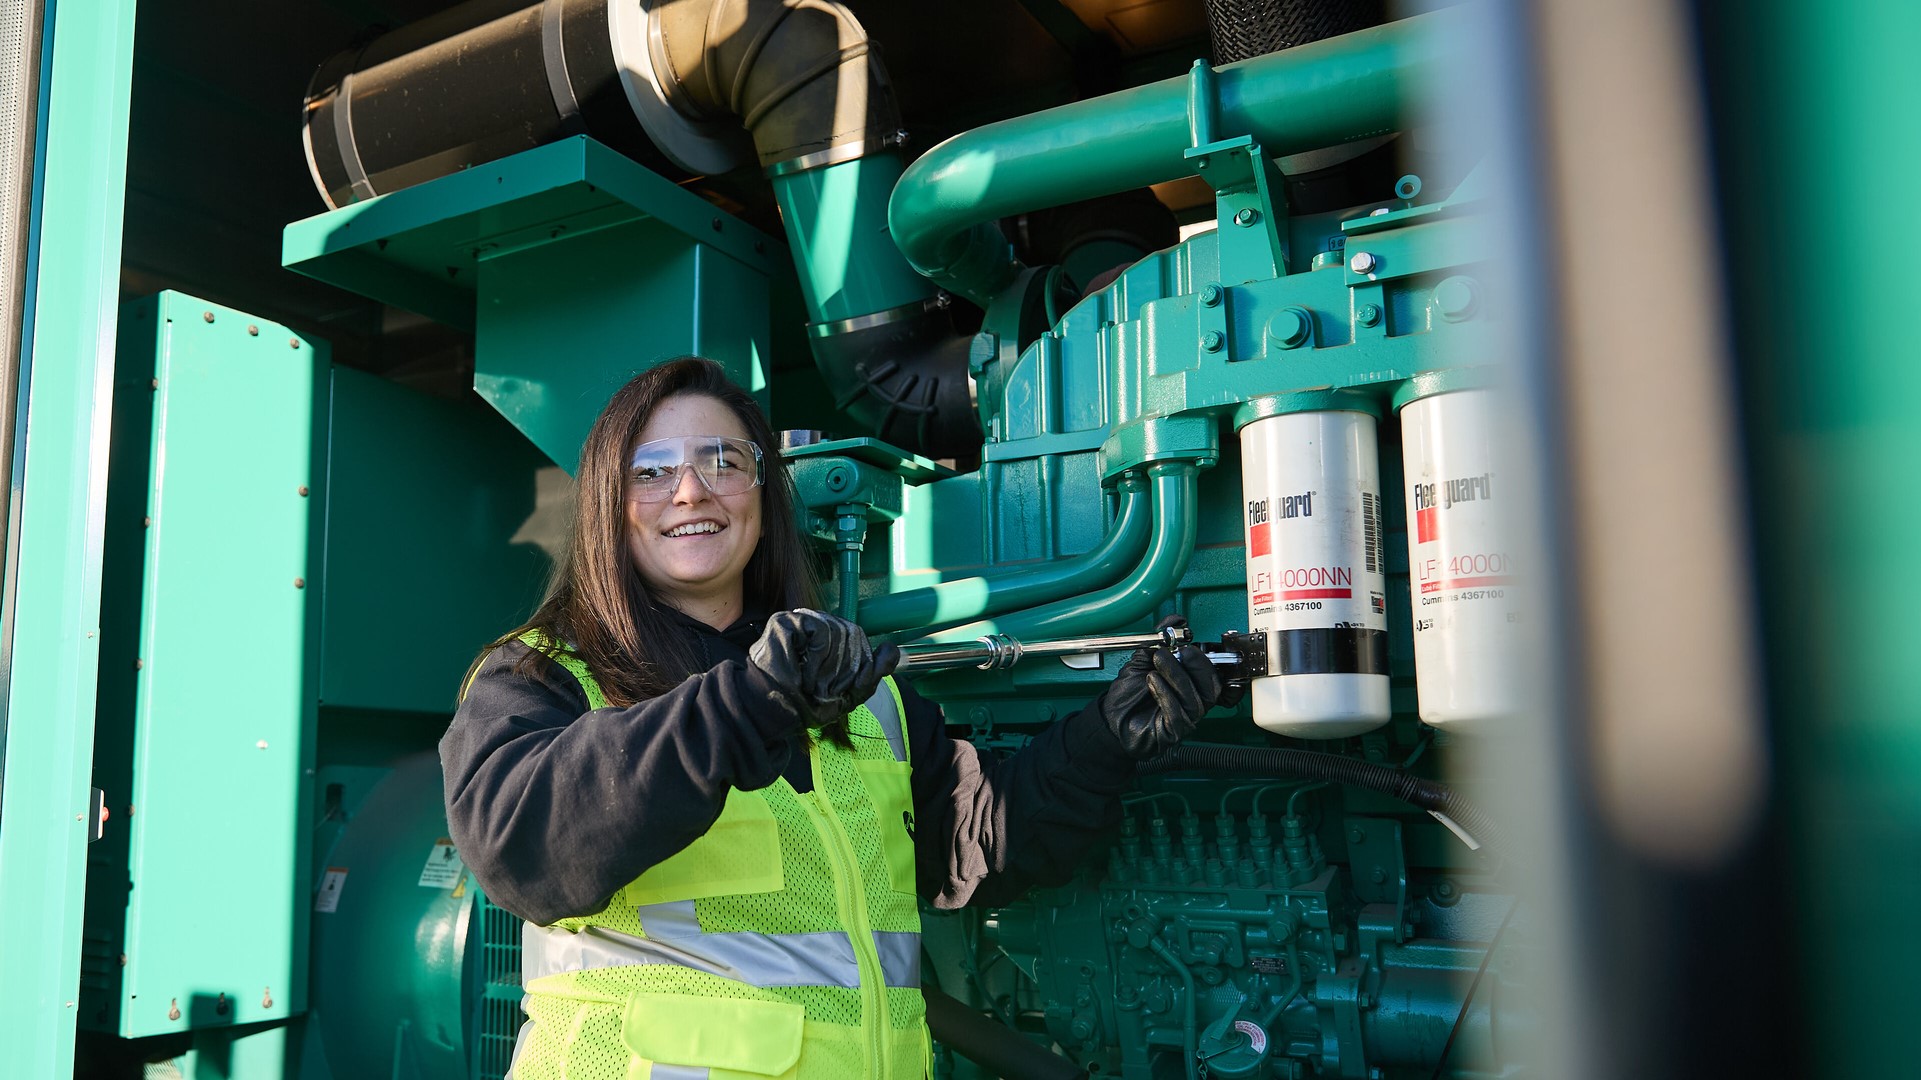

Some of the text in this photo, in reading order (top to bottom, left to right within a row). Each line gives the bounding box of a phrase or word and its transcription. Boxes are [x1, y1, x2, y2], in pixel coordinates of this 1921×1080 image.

[1414, 473, 1490, 510] Fleeguard
[1248, 491, 1312, 526] Fleetuard
[1251, 567, 1352, 593] LF14000NN
[1418, 553, 1518, 581] LF4000N
[1284, 602, 1322, 611] 4367100
[1422, 590, 1504, 605] Cummns 4367100
